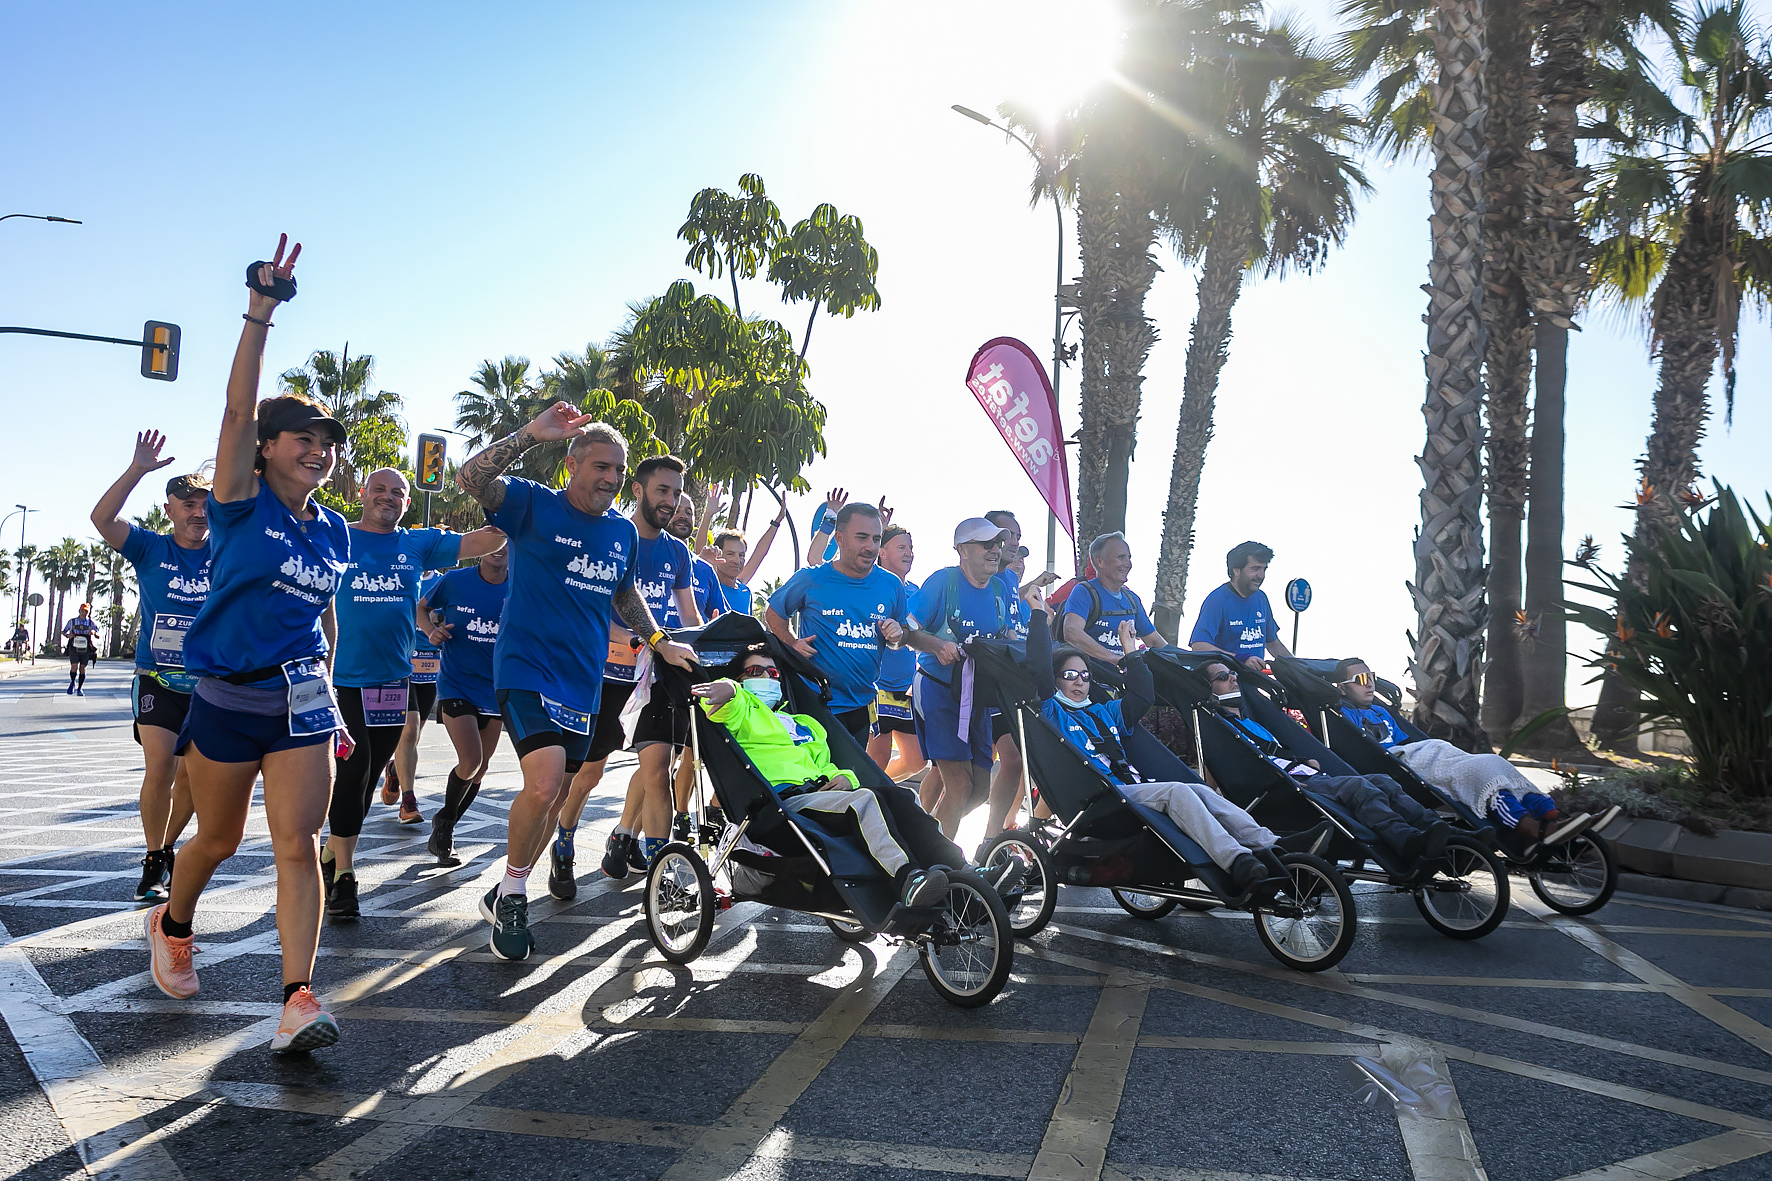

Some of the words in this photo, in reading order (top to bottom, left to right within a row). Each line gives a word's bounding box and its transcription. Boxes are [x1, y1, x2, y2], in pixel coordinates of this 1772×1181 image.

[555, 534, 582, 548] aefat
[166, 592, 207, 602] #Imparabl
[353, 595, 404, 603] #Imparables
[822, 608, 844, 616] aefat
[962, 619, 975, 627] fat
[467, 634, 497, 644] #Imparab
